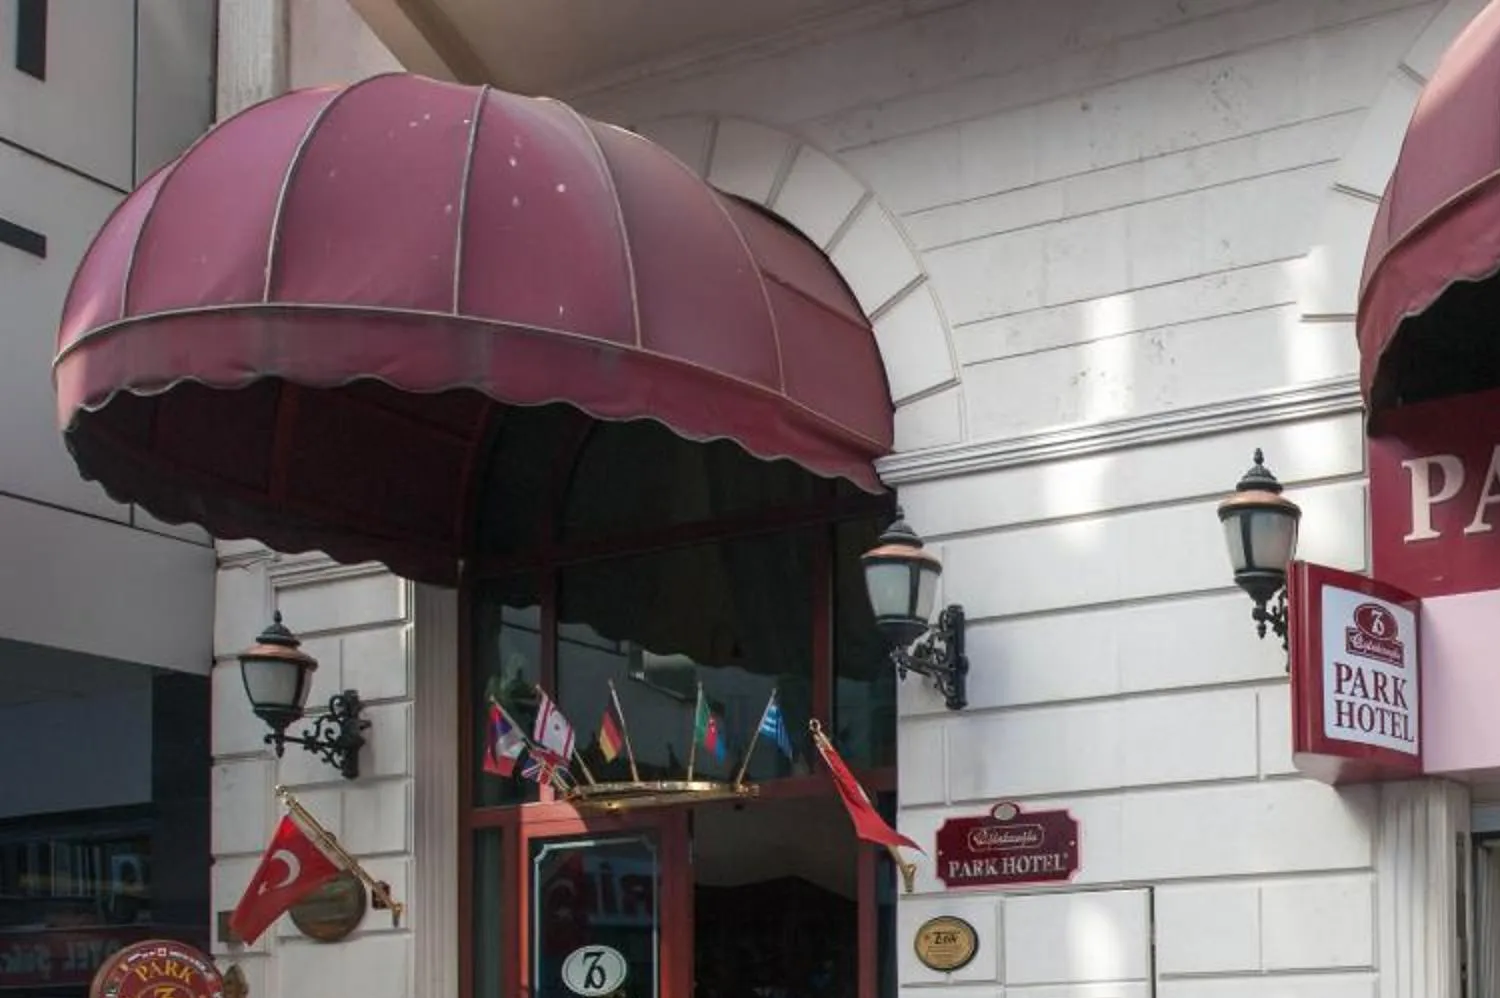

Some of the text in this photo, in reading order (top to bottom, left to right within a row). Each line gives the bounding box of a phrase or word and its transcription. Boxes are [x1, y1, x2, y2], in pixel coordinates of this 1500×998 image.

[1333, 661, 1409, 711] PARK
[1334, 699, 1415, 743] HOTEL
[948, 853, 1067, 879] PARK HOTEL
[135, 959, 194, 985] PARK
